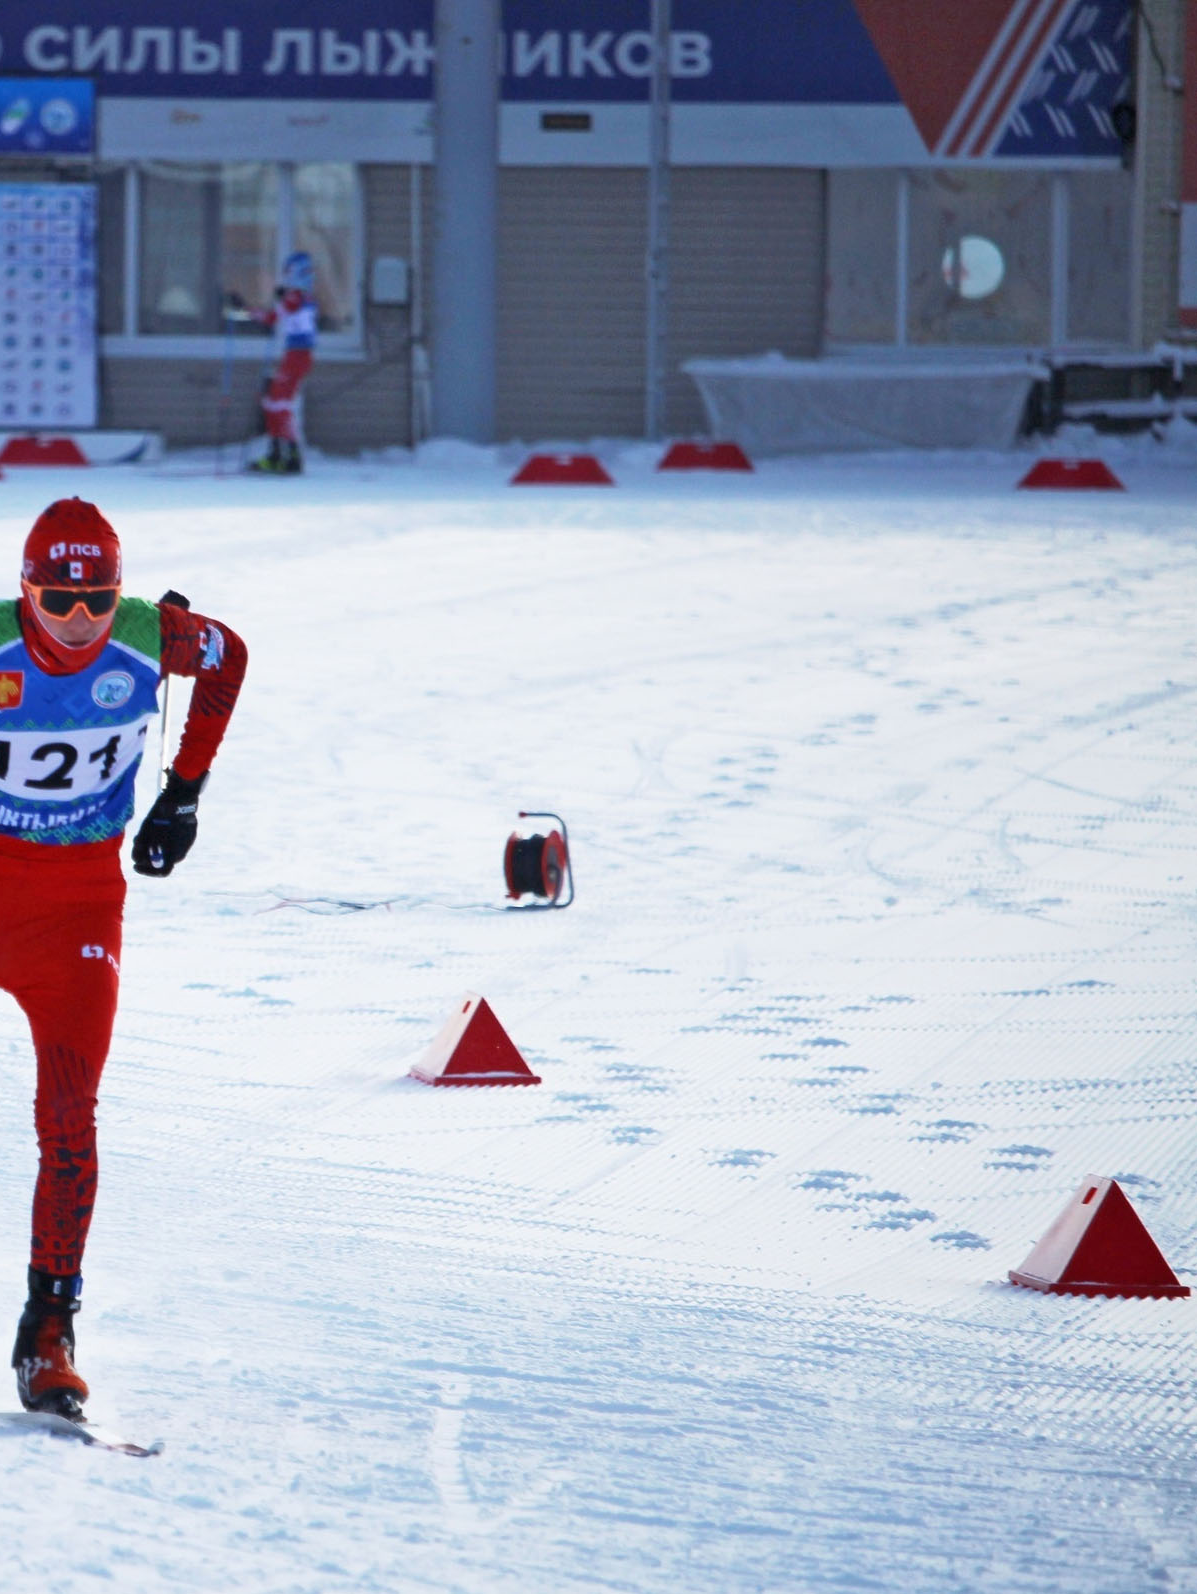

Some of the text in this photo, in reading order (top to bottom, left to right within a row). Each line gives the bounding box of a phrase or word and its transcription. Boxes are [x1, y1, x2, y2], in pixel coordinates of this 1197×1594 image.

[24, 25, 240, 74] силы
[263, 28, 713, 78] лыжиков
[69, 543, 101, 557] ПСБ
